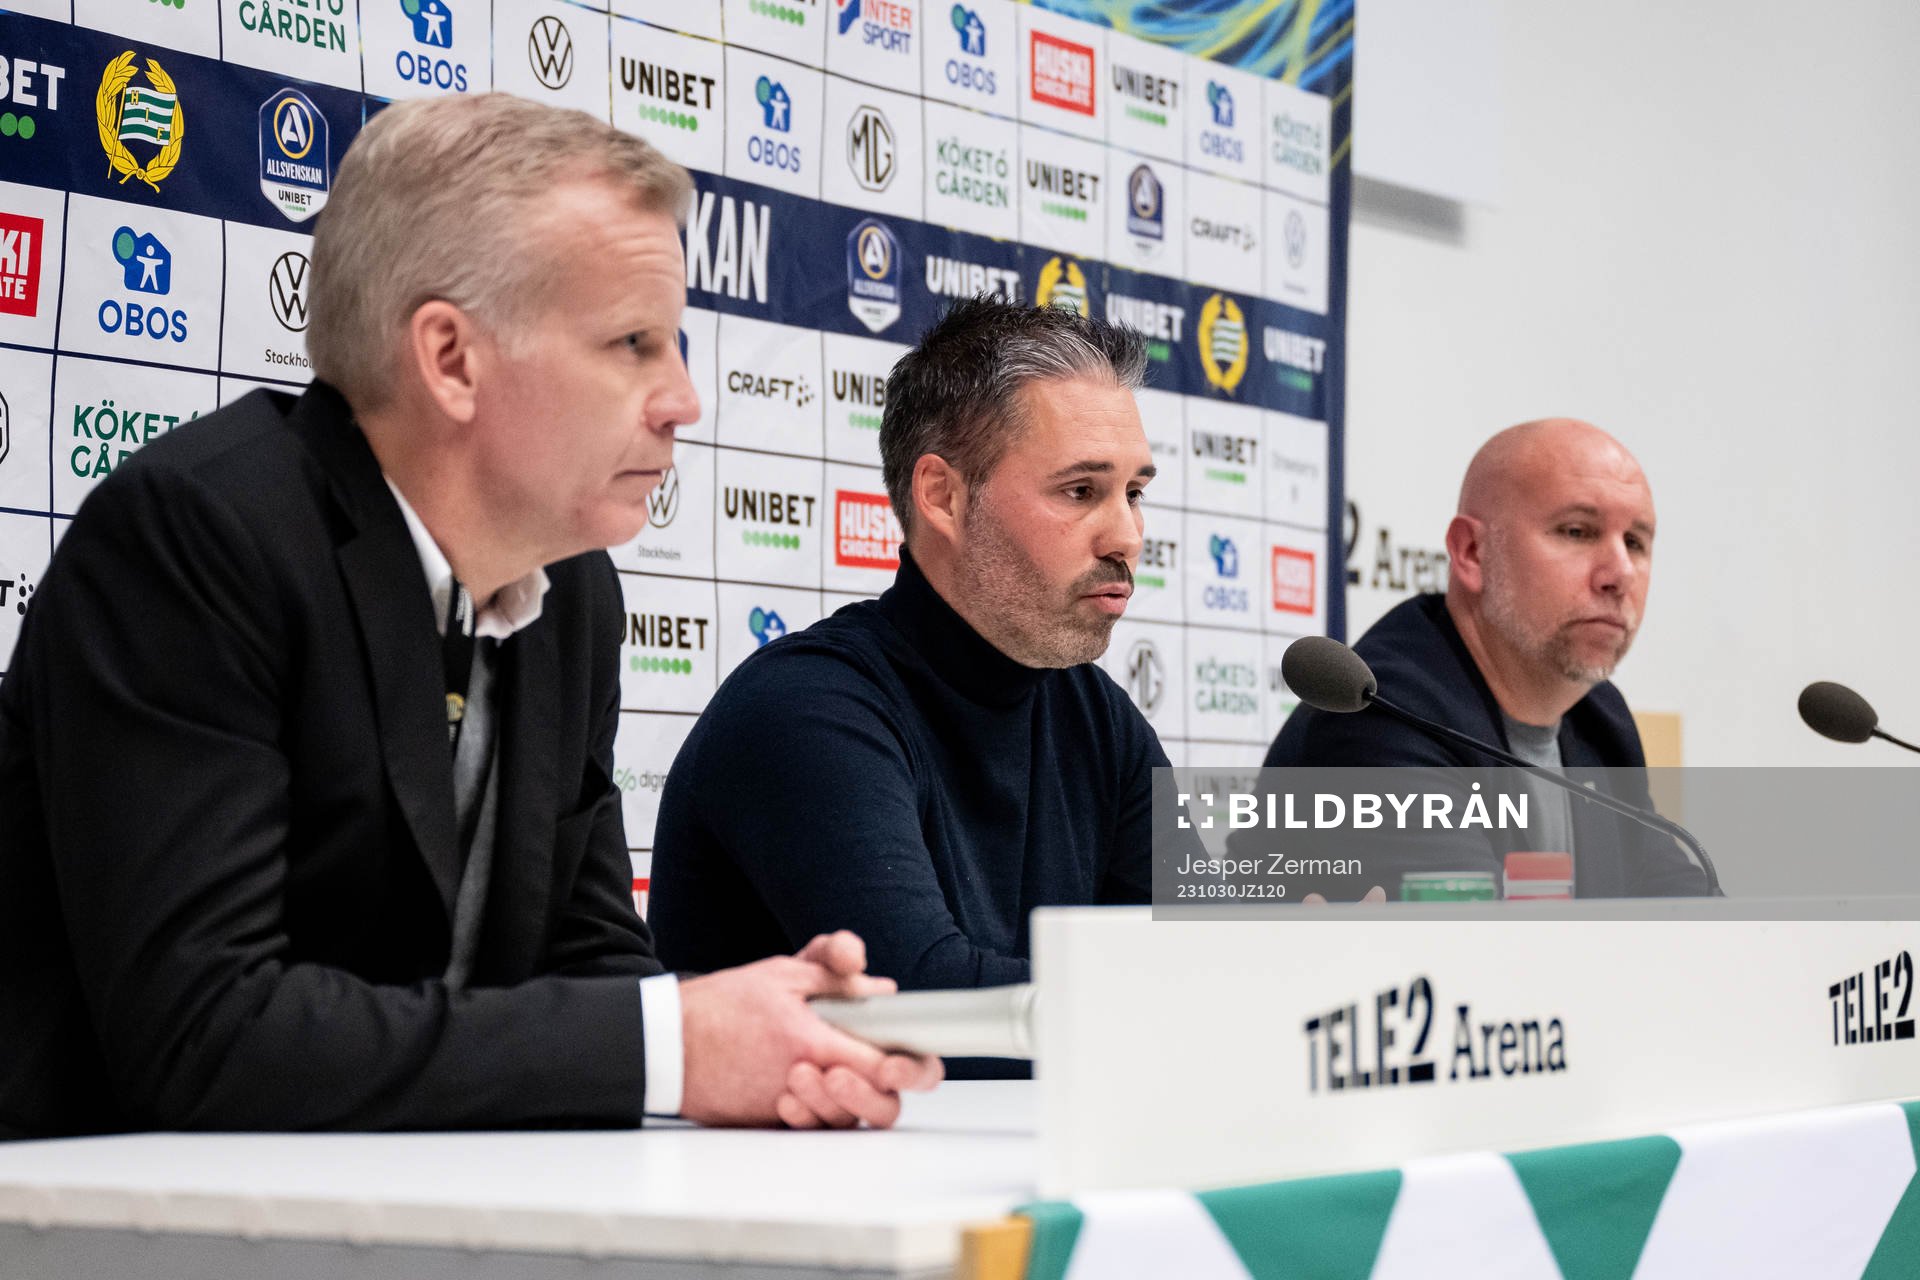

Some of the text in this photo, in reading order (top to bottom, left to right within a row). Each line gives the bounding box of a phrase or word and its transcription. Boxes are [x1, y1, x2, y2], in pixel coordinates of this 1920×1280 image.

[239, 1, 346, 53] GÅRDEN
[863, 21, 911, 55] SPORT
[396, 50, 467, 92] OBOS
[620, 56, 716, 110] UNIBET
[946, 59, 996, 96] OBOS
[1112, 64, 1179, 109] UNIBET
[266, 158, 323, 185] ALLSVENSKAN
[748, 136, 801, 173] OBOS
[278, 189, 312, 206] UNIBET
[935, 170, 1008, 208] GÅRDEN
[1026, 159, 1100, 204] UNIBET
[98, 299, 188, 343] OBOS
[728, 371, 794, 400] CRAFT
[1192, 430, 1258, 465] UNIBET
[725, 486, 816, 527] UNIBET
[1829, 951, 1915, 1046] TELE2
[1305, 977, 1567, 1093] TELE2 Arena
